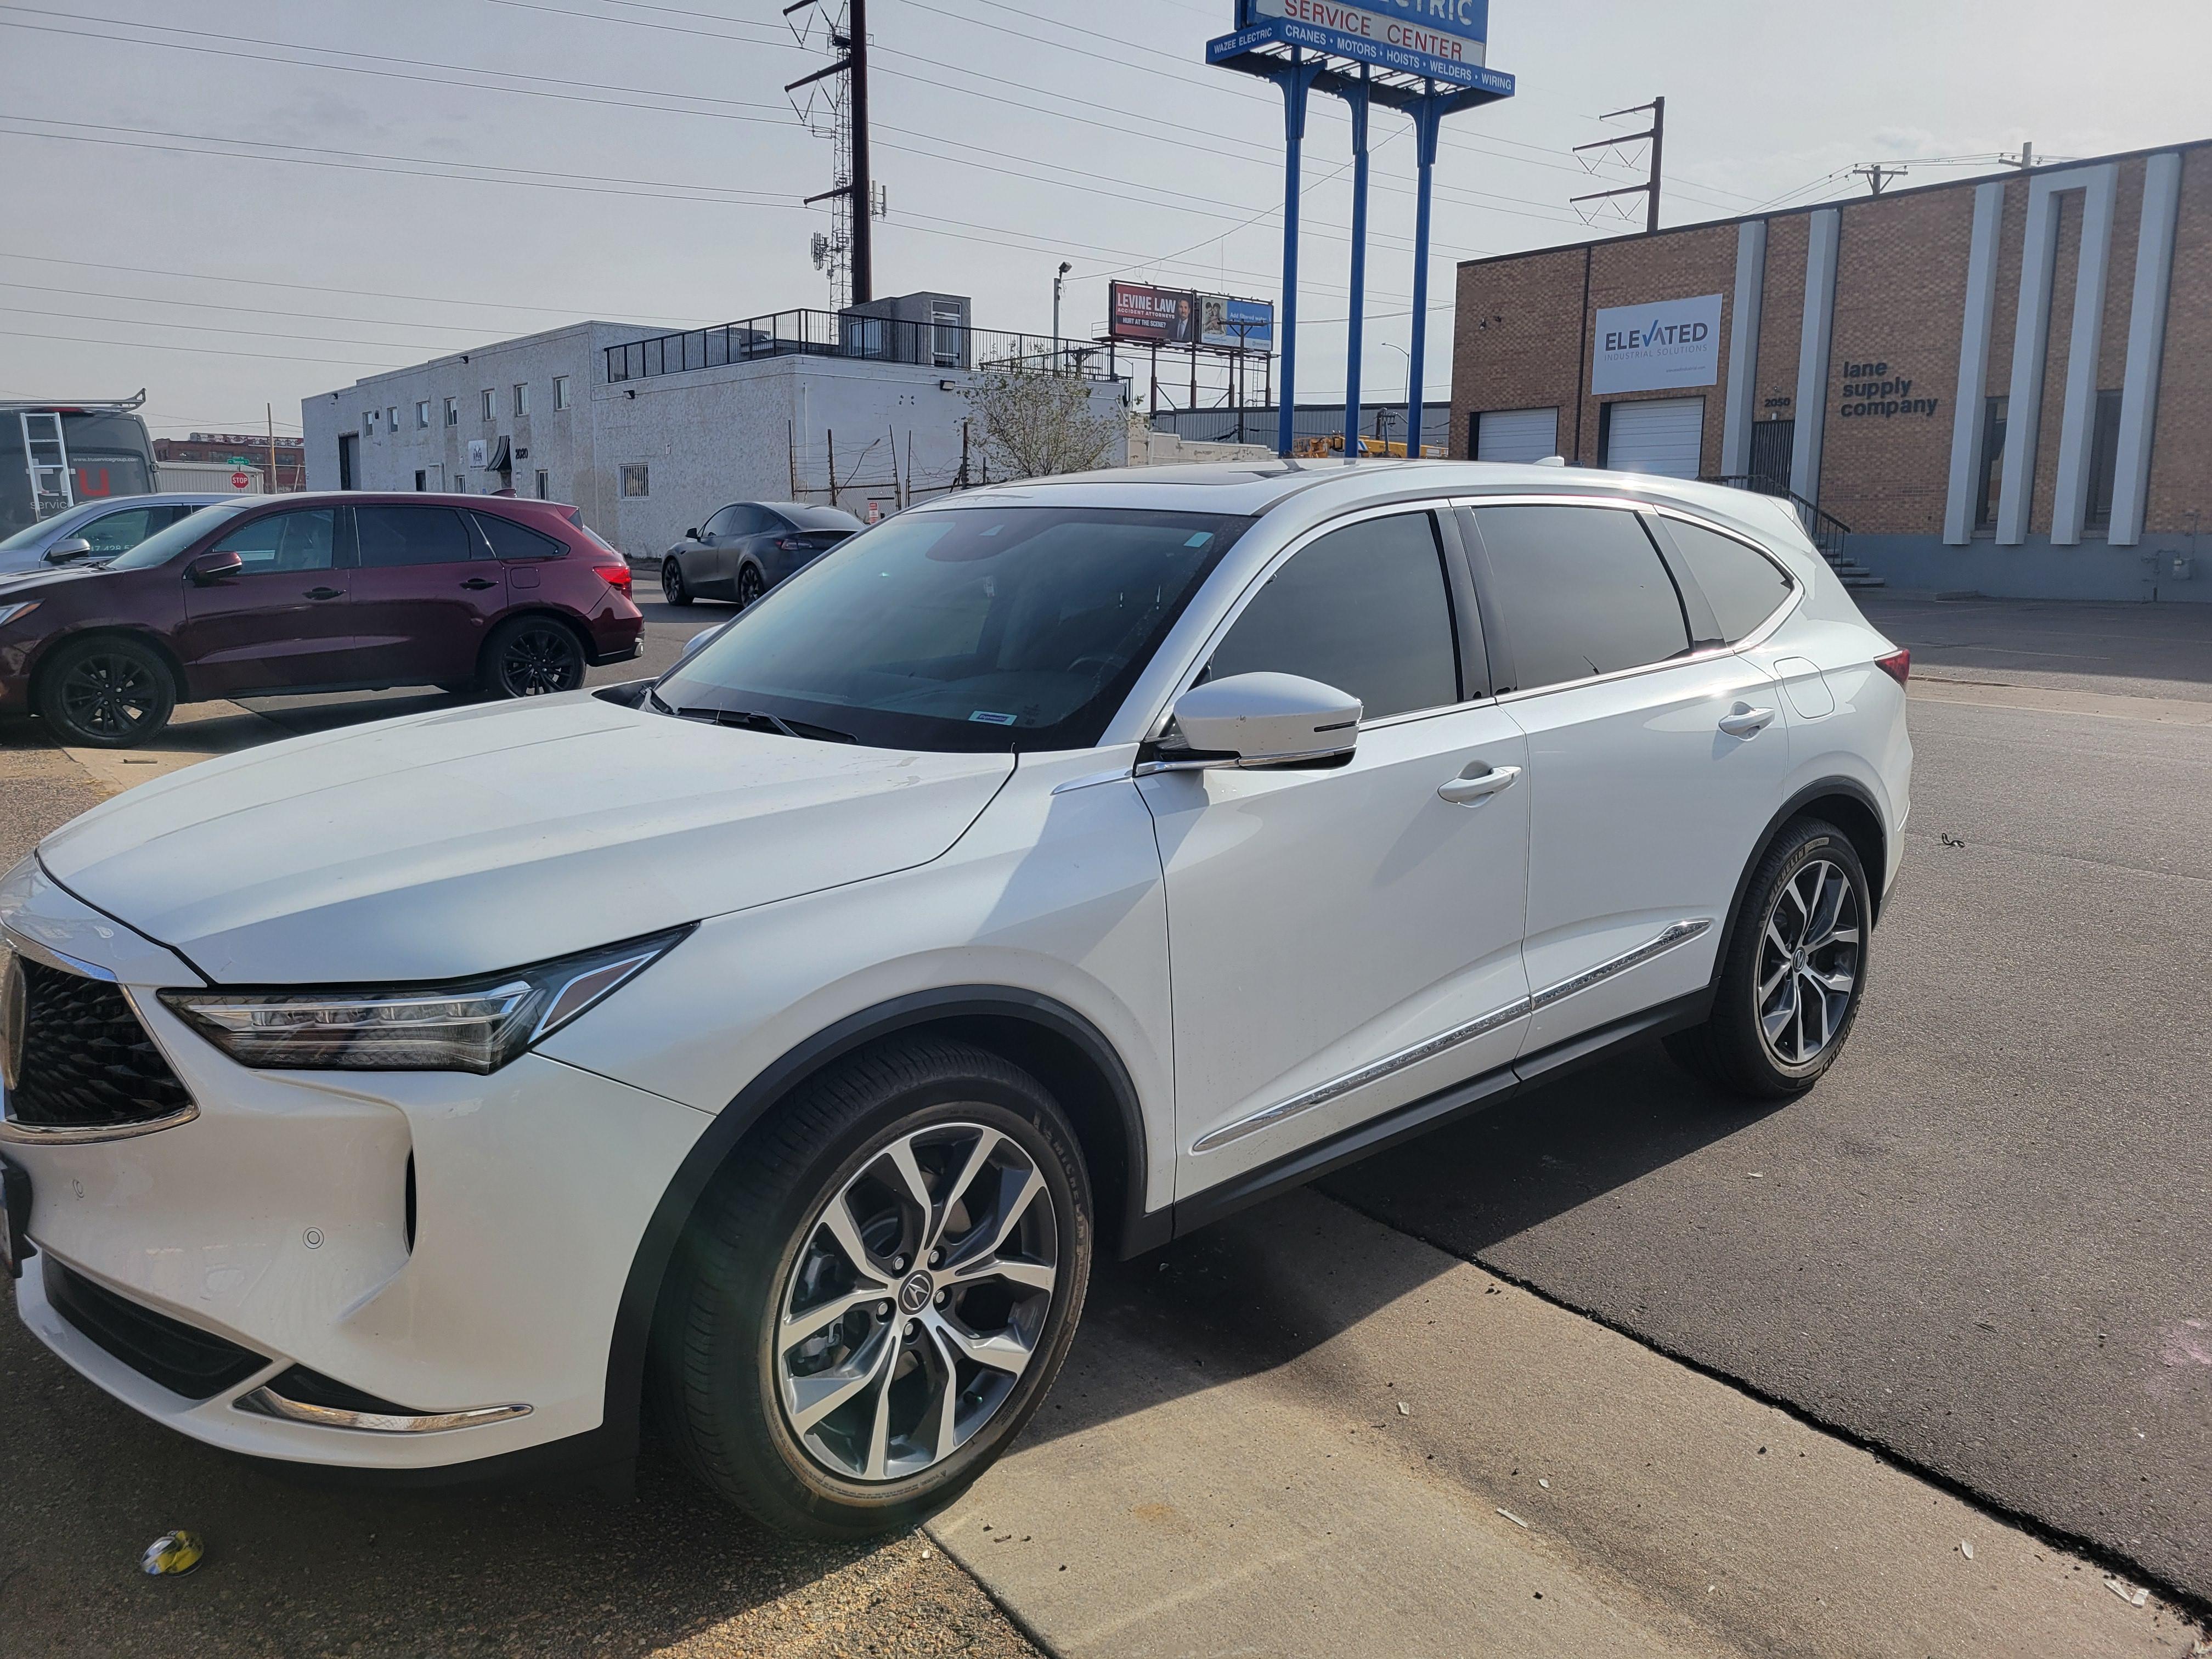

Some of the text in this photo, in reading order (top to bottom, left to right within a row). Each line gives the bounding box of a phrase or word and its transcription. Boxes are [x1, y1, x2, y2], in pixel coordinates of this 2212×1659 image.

[1214, 27, 1272, 54] WAZEE ELECTRIC
[1284, 0, 1462, 61] SERVICE CENTER
[1285, 25, 1511, 90] CRANES MOTORS HOISTS WELDERS WIRING
[1118, 292, 1176, 313] LEVINE LAW
[1146, 311, 1175, 319] ATTORNEYS
[1605, 319, 1708, 351] ELEVATED
[1605, 344, 1707, 361] INDUSTRIAL SOLUTIONS
[1843, 361, 1888, 378] lane
[1843, 377, 1912, 399] supply
[1764, 397, 1790, 408] 2050
[1841, 397, 1938, 418] company
[516, 447, 528, 459] 2020
[30, 499, 70, 510] servic
[1769, 848, 1804, 904] MICHELIN
